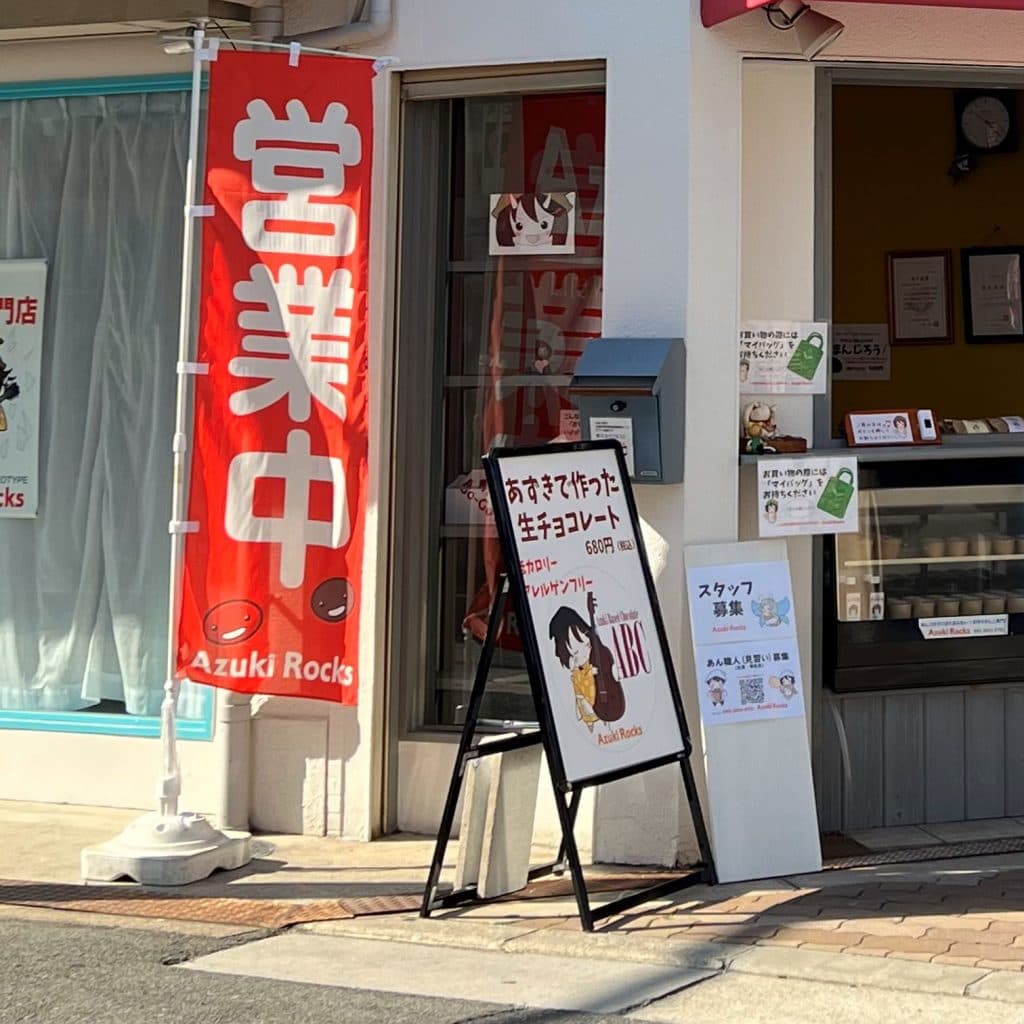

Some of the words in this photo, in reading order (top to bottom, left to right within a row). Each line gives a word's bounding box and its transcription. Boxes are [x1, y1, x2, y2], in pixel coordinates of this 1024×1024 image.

[0, 296, 38, 325] 門店
[224, 98, 362, 589] 営業中
[832, 344, 881, 356] まんじろう
[518, 505, 620, 542] 生チョコレート
[585, 536, 615, 555] 680円
[698, 581, 753, 598] スタッフ
[712, 600, 744, 618] 募集
[612, 621, 652, 679] ABC
[191, 650, 275, 678] Azuki
[283, 651, 354, 686] Rocks
